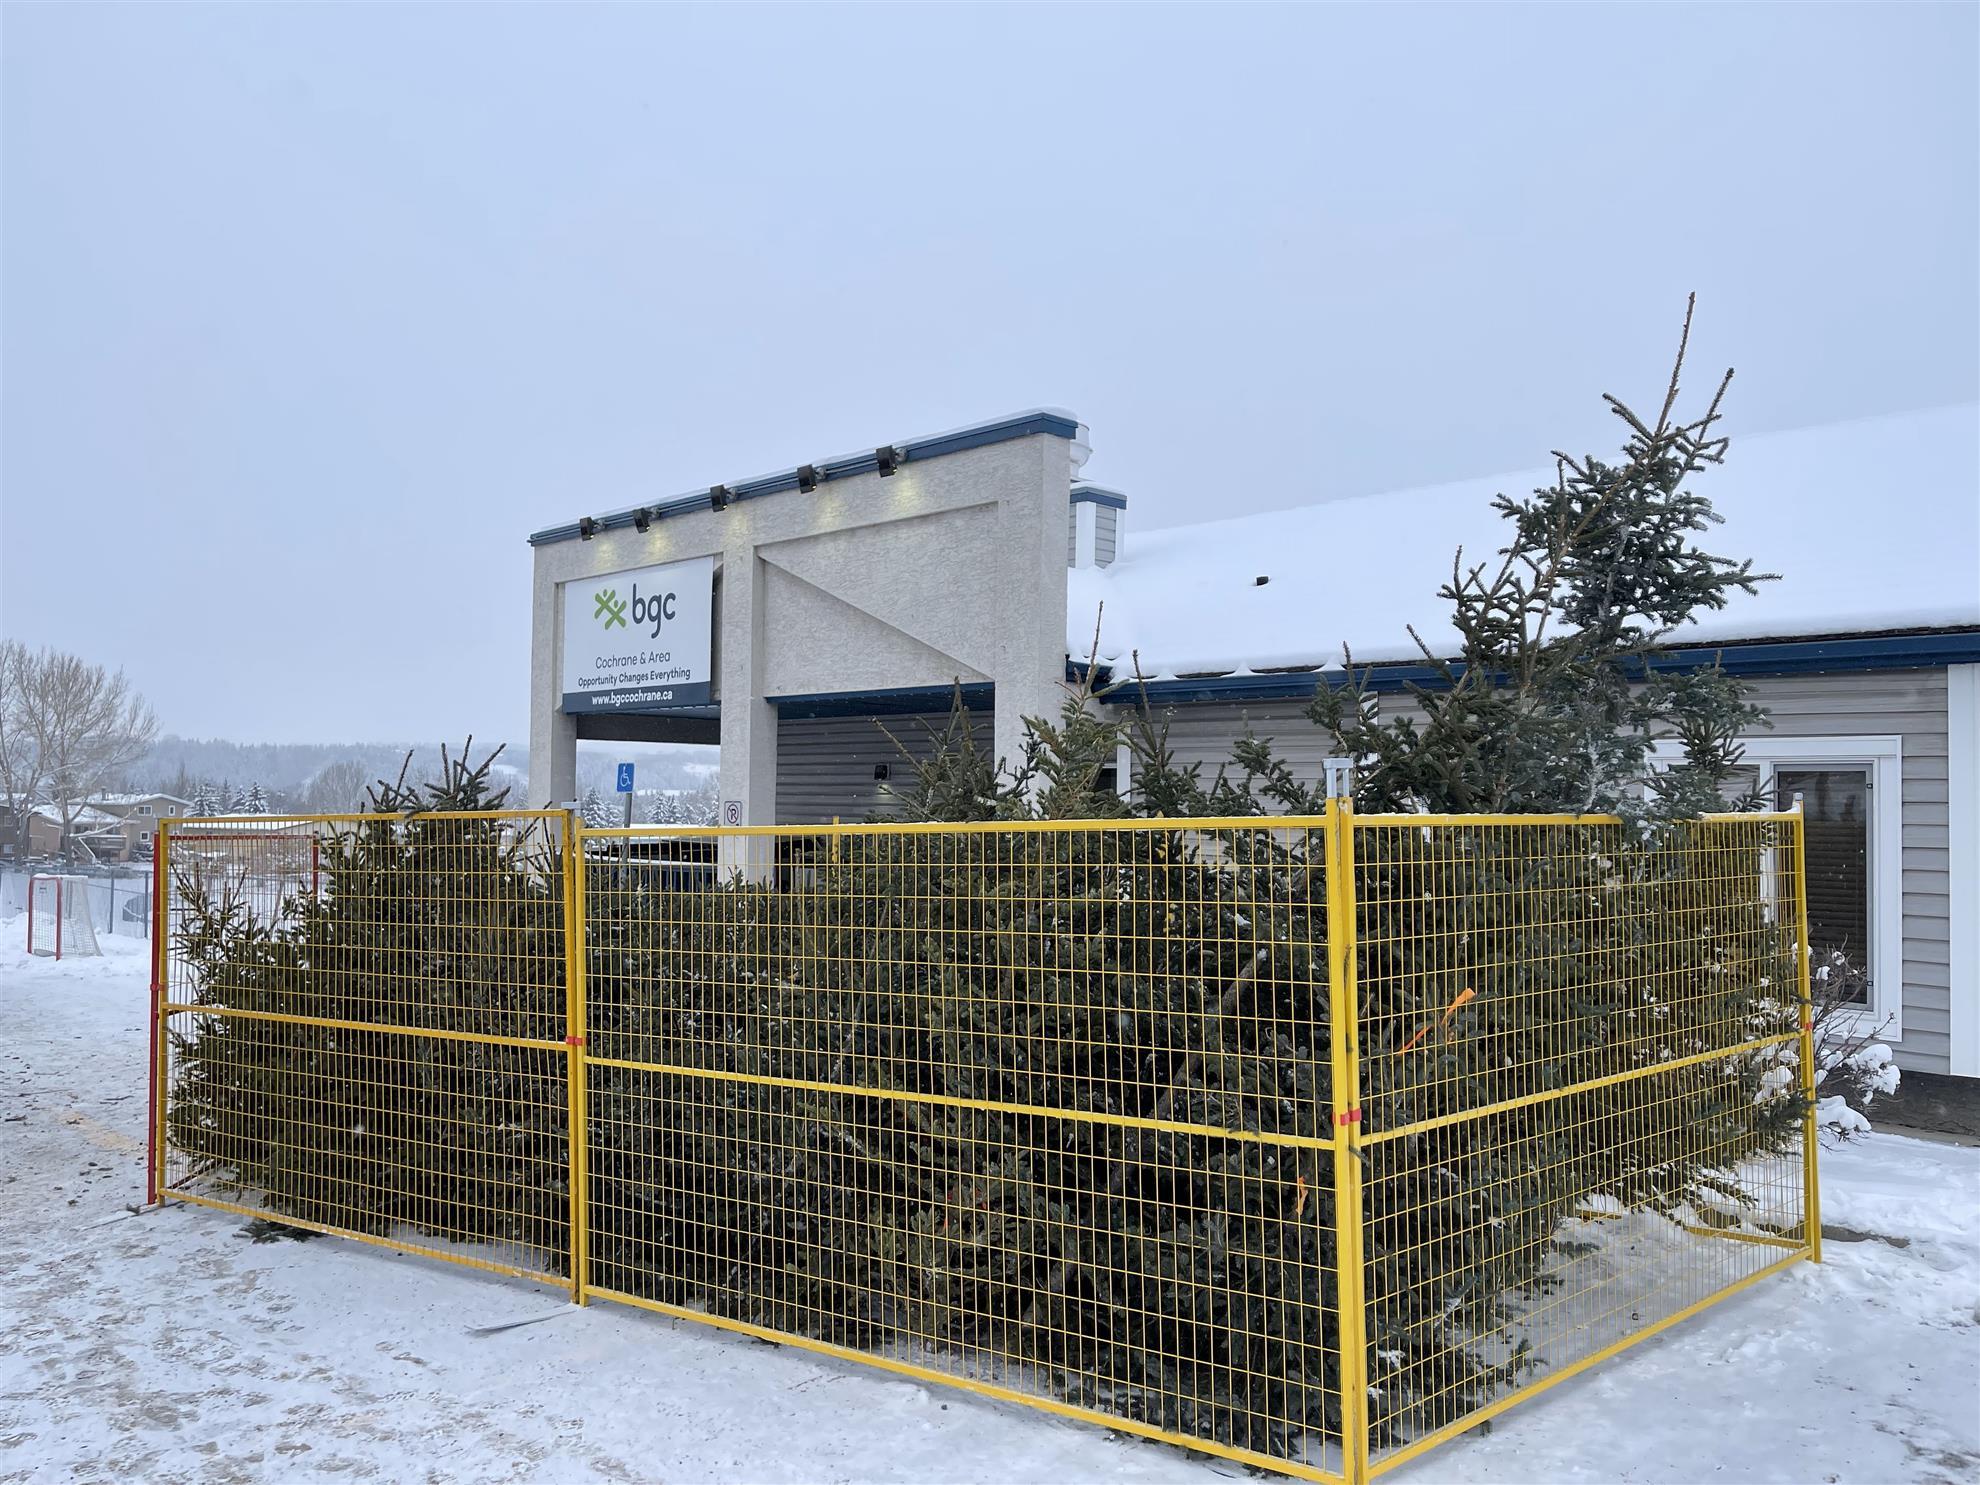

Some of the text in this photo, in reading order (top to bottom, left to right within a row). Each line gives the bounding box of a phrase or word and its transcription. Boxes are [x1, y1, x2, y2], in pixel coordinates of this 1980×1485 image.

[632, 583, 676, 639] bgc
[595, 650, 671, 669] Cochrane & Area
[578, 667, 691, 689] Opportunity Changes Everything
[591, 690, 673, 706] www.bgccochrane.ca
